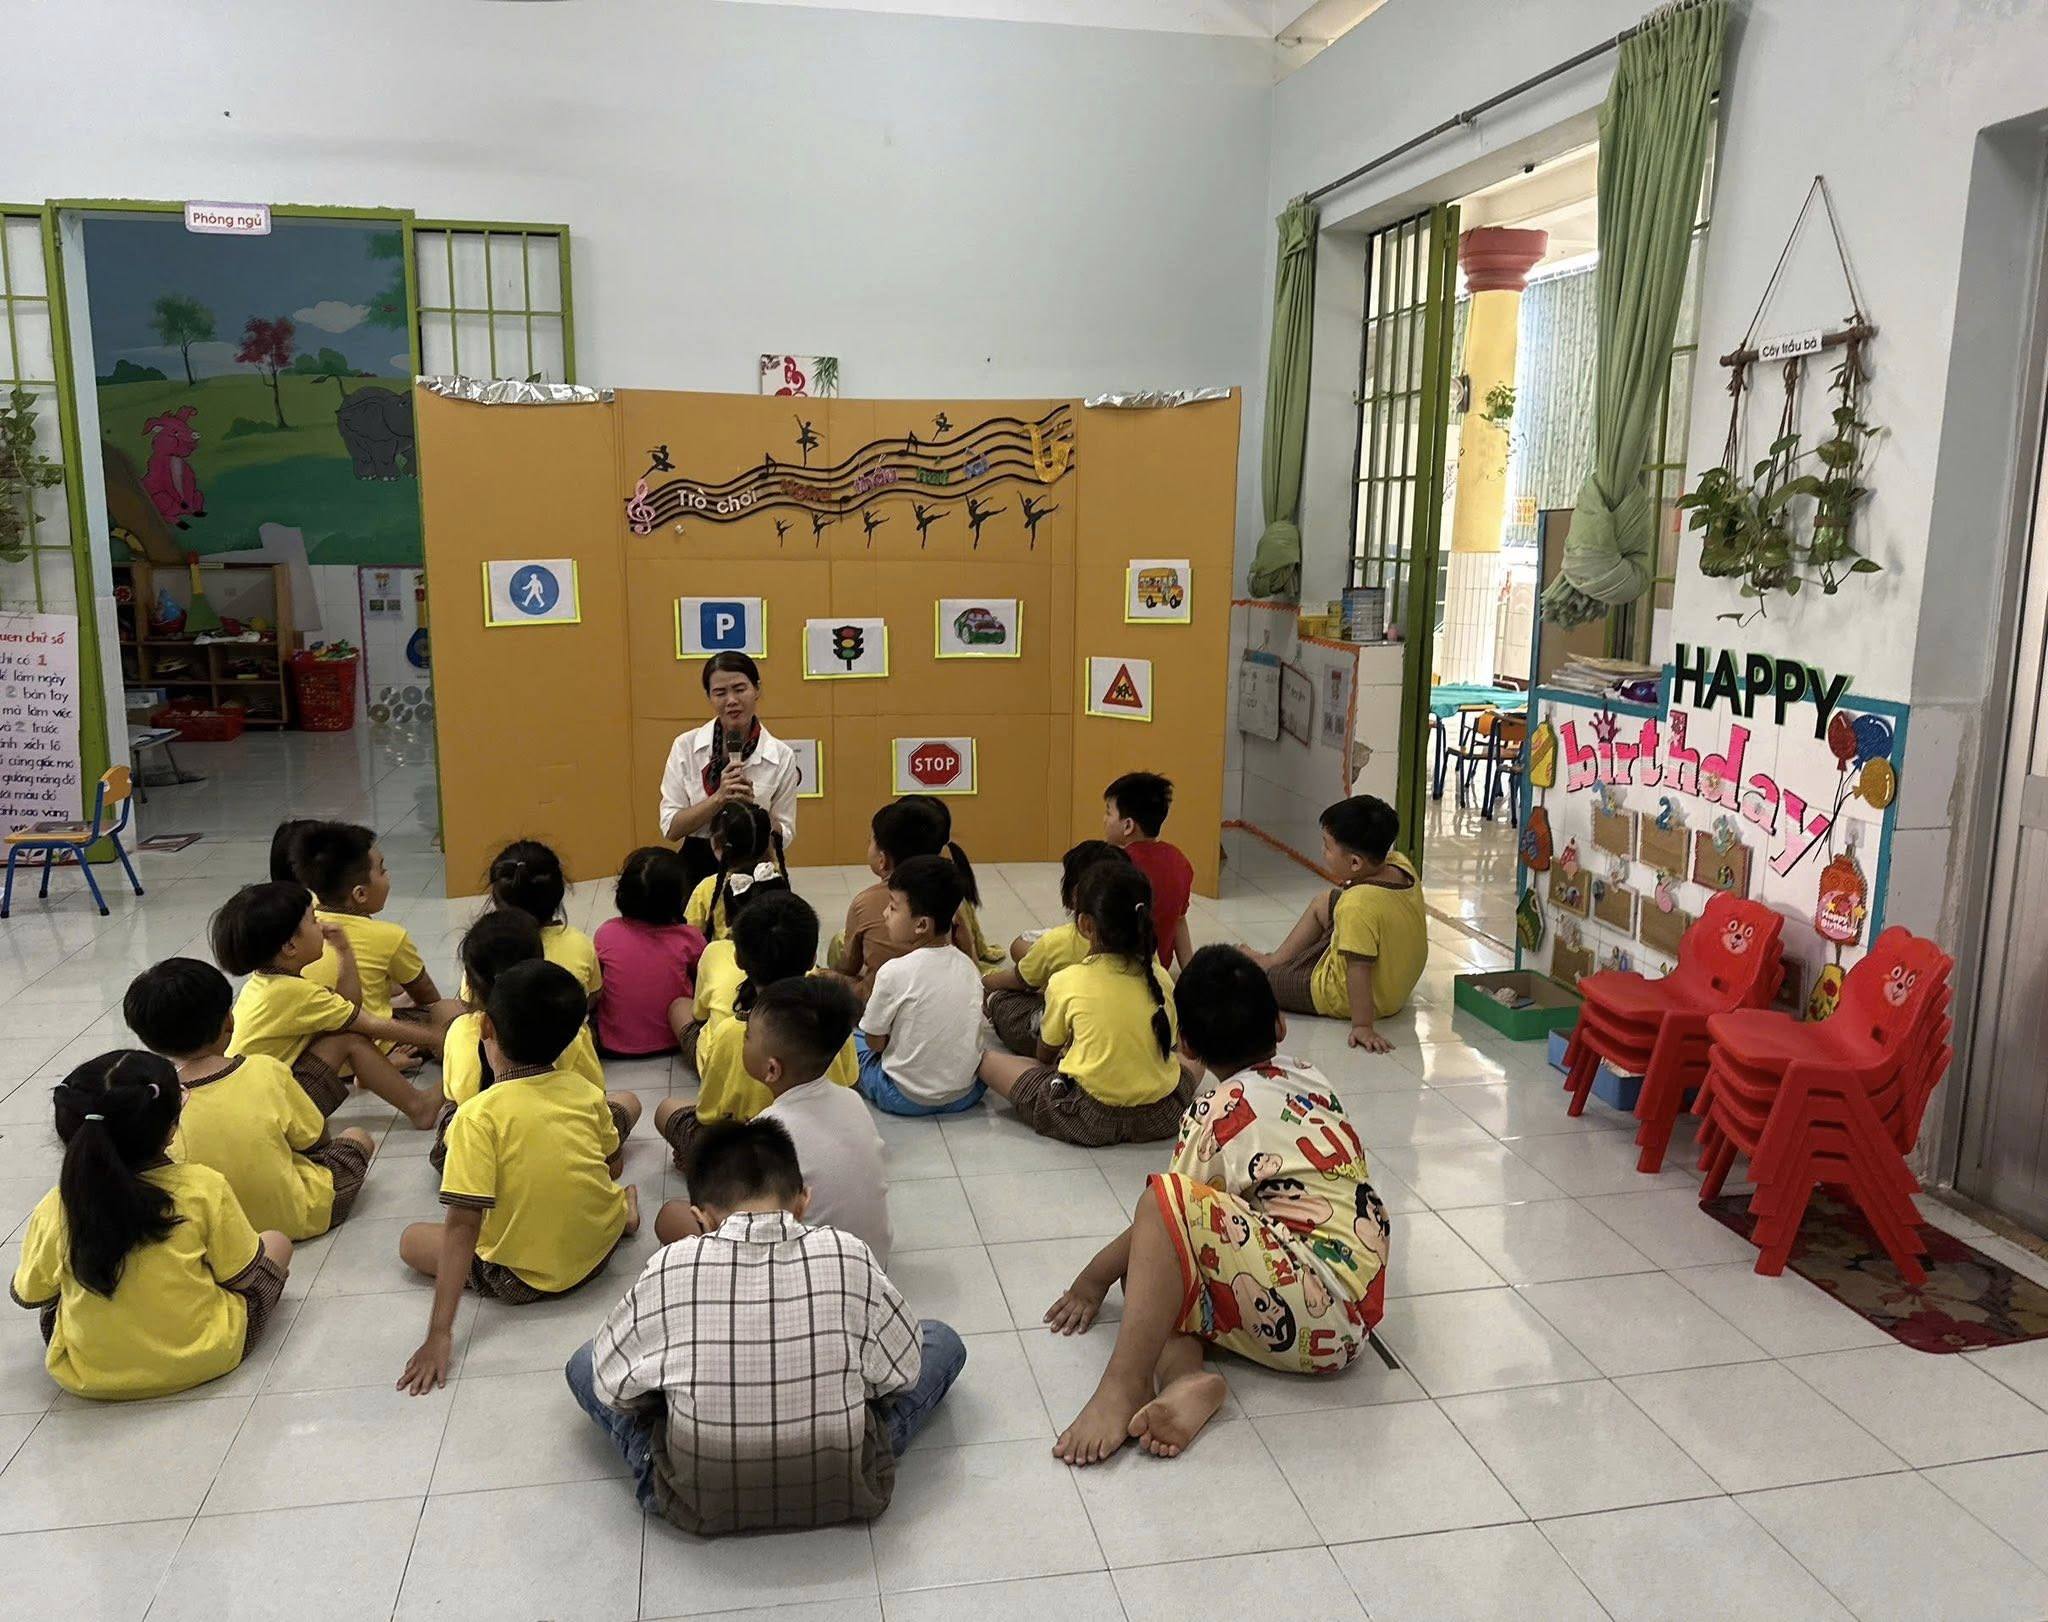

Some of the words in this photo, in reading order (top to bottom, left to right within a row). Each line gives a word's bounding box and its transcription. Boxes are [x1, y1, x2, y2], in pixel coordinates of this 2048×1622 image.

[193, 212, 234, 228] Phòng
[238, 213, 262, 229] ngủ
[677, 487, 707, 510] Trò
[716, 488, 758, 514] chơi
[716, 613, 736, 640] P
[52, 631, 66, 645] số
[17, 653, 30, 666] có
[37, 654, 47, 667] 1
[14, 670, 34, 682] làm
[38, 671, 66, 687] ngày
[6, 685, 17, 699] 2
[23, 687, 46, 700] bàn
[50, 689, 69, 704] tay
[1673, 643, 1855, 741] HAPPY
[3, 705, 21, 716] mà
[28, 704, 48, 717] làm
[15, 721, 26, 733] 2
[24, 737, 45, 750] xích
[50, 740, 61, 752] lô
[8, 755, 34, 770] cùng
[914, 756, 955, 773] STOP
[14, 788, 38, 801] màu
[1560, 709, 1830, 877] birthday
[41, 806, 69, 821] vàng
